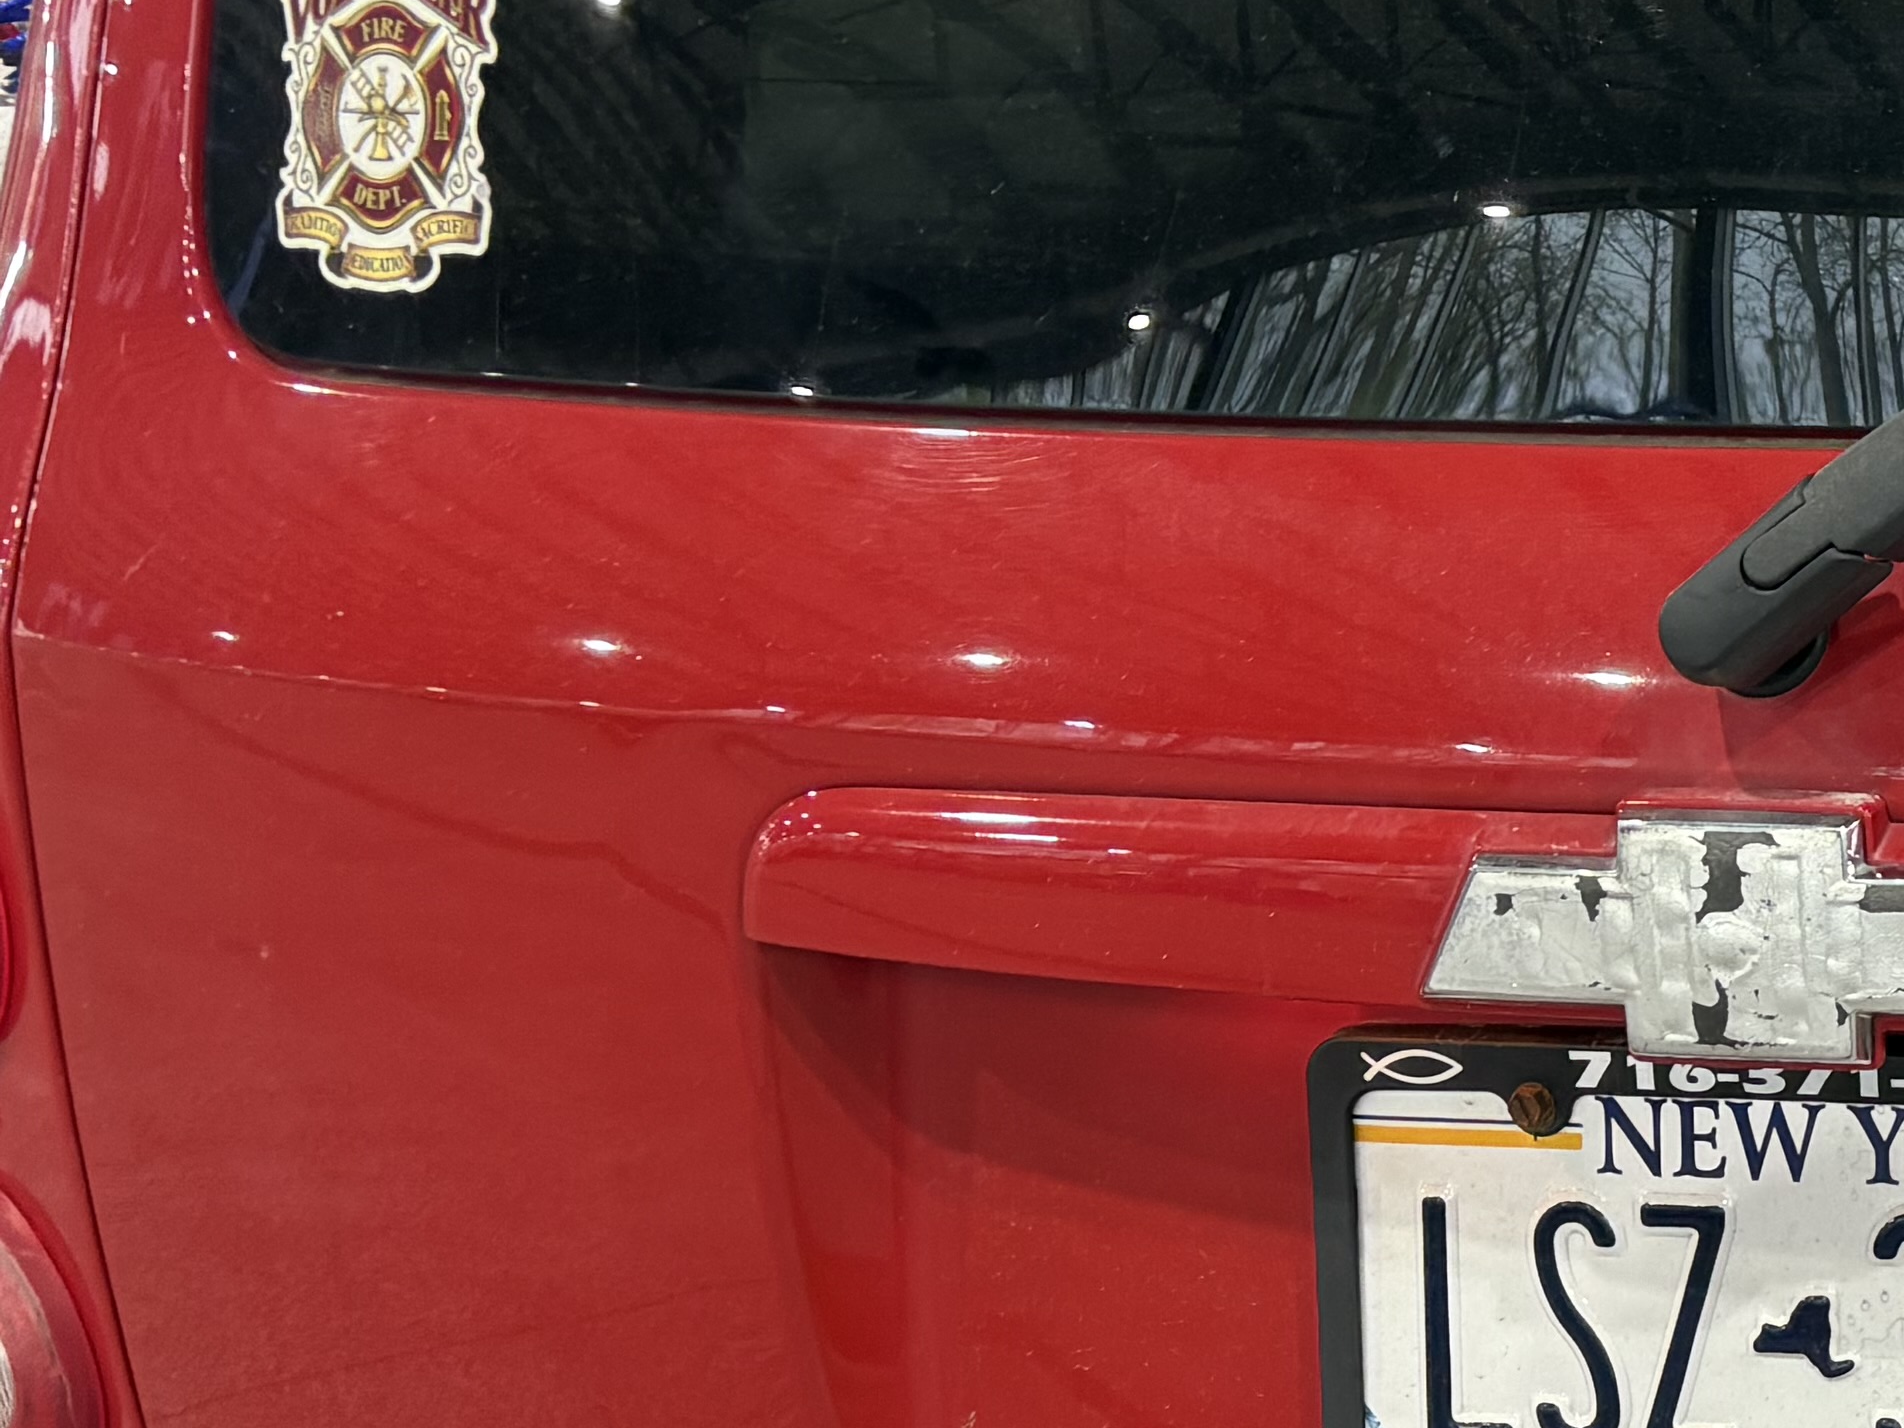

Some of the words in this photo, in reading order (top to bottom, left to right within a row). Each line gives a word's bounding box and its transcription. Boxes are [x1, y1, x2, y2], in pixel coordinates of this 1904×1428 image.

[360, 17, 408, 43] FIRE
[353, 184, 407, 212] DEPT.
[1595, 1095, 1826, 1180] NEW
